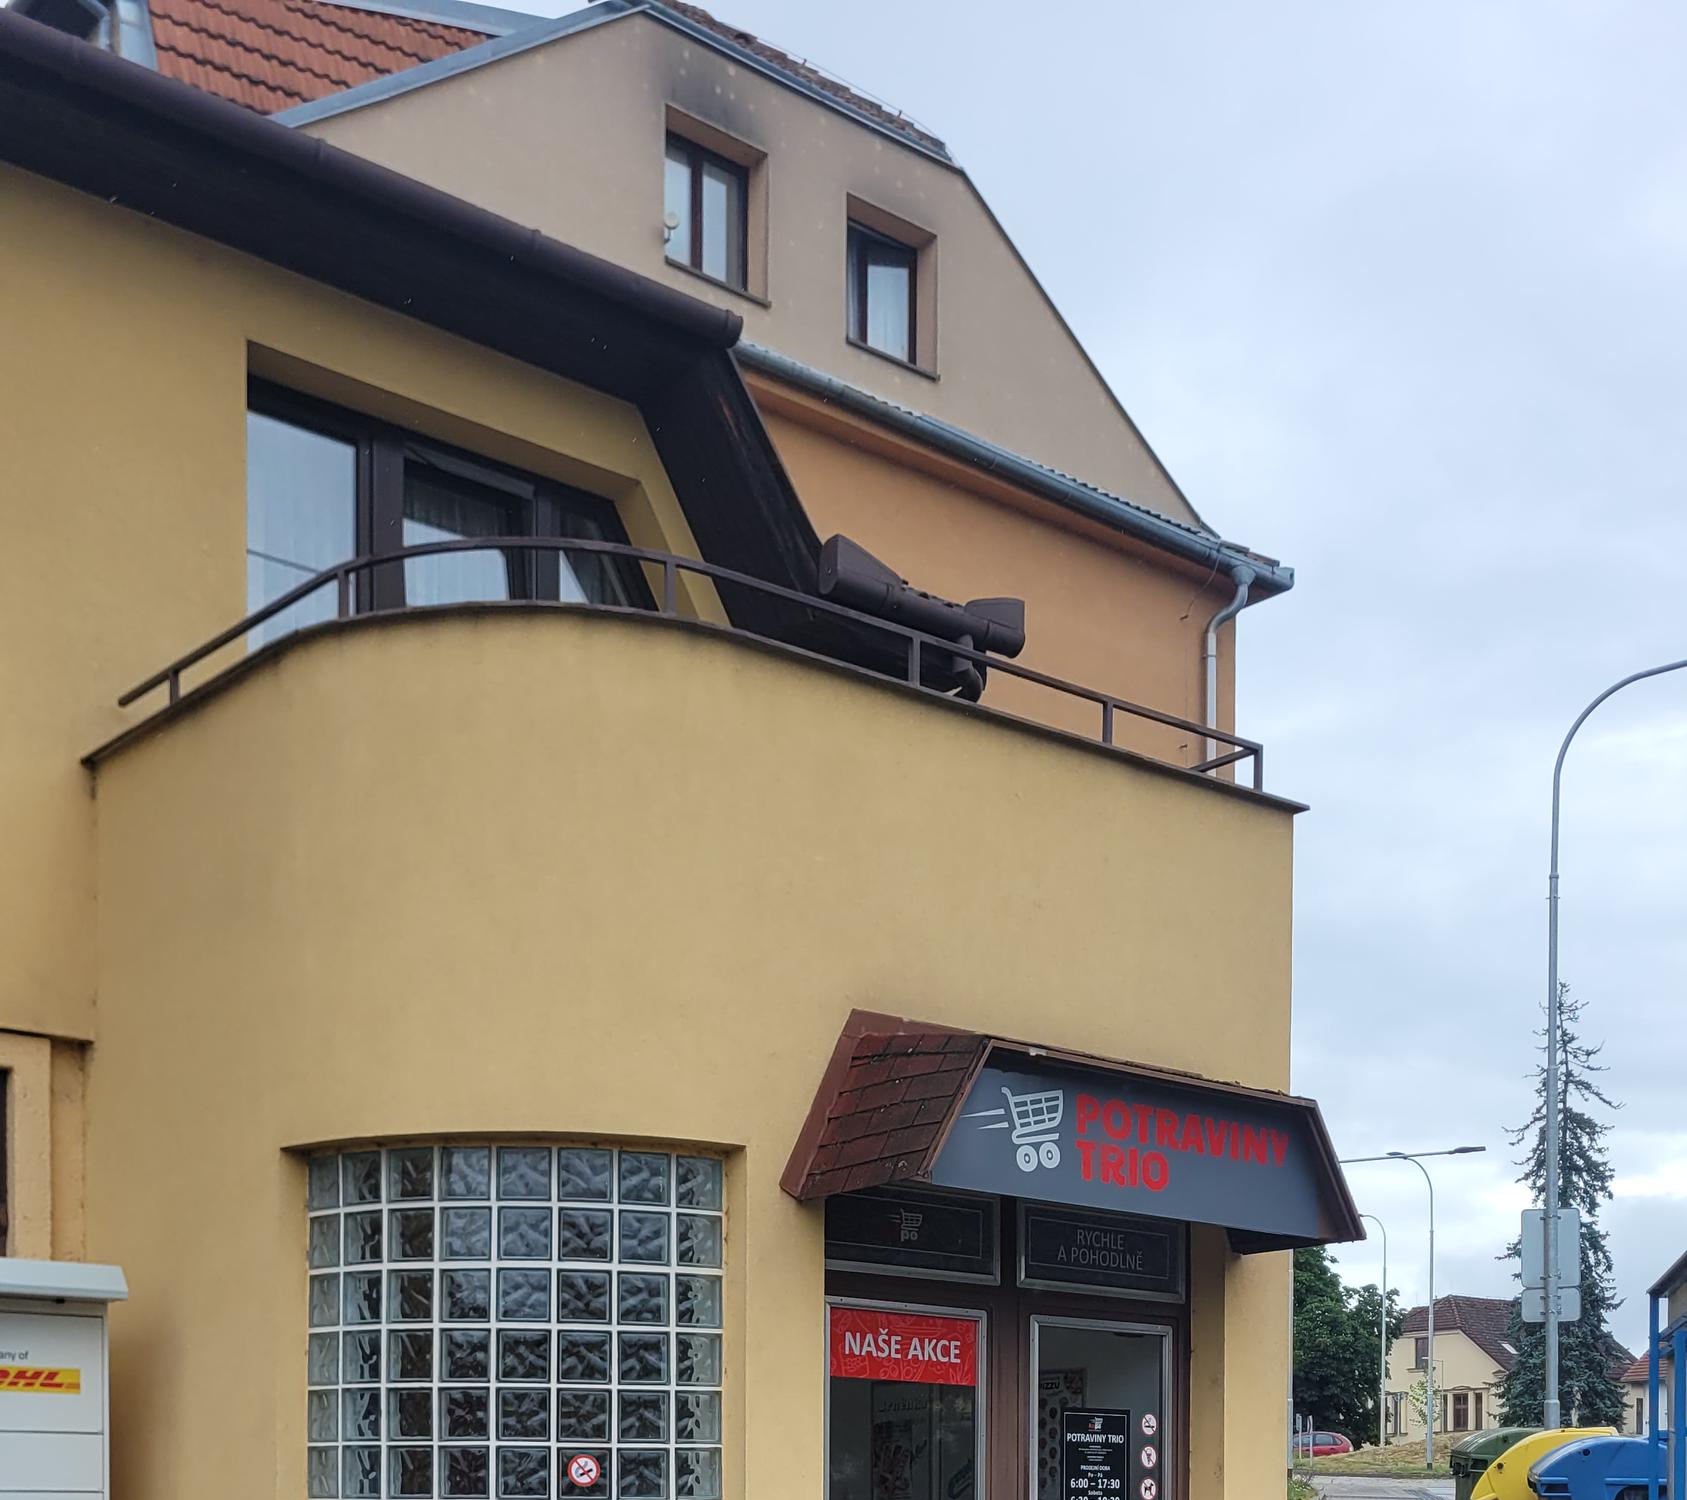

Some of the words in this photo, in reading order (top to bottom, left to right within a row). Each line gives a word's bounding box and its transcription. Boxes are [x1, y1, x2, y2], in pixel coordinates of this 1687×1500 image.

[1075, 1093, 1290, 1168] POTRAVINY
[1075, 1140, 1170, 1192] TRIO
[1077, 1229, 1125, 1250] RYCHLE
[1057, 1245, 1067, 1262] A
[1071, 1247, 1143, 1270] POHODLNĚ
[844, 1328, 902, 1359] NAŠE
[907, 1337, 961, 1363] AKCE
[1067, 1433, 1106, 1443] POTRAVINY
[1107, 1434, 1124, 1444] TRIO
[1070, 1478, 1089, 1488] 6:00
[1098, 1479, 1120, 1489] 17:30
